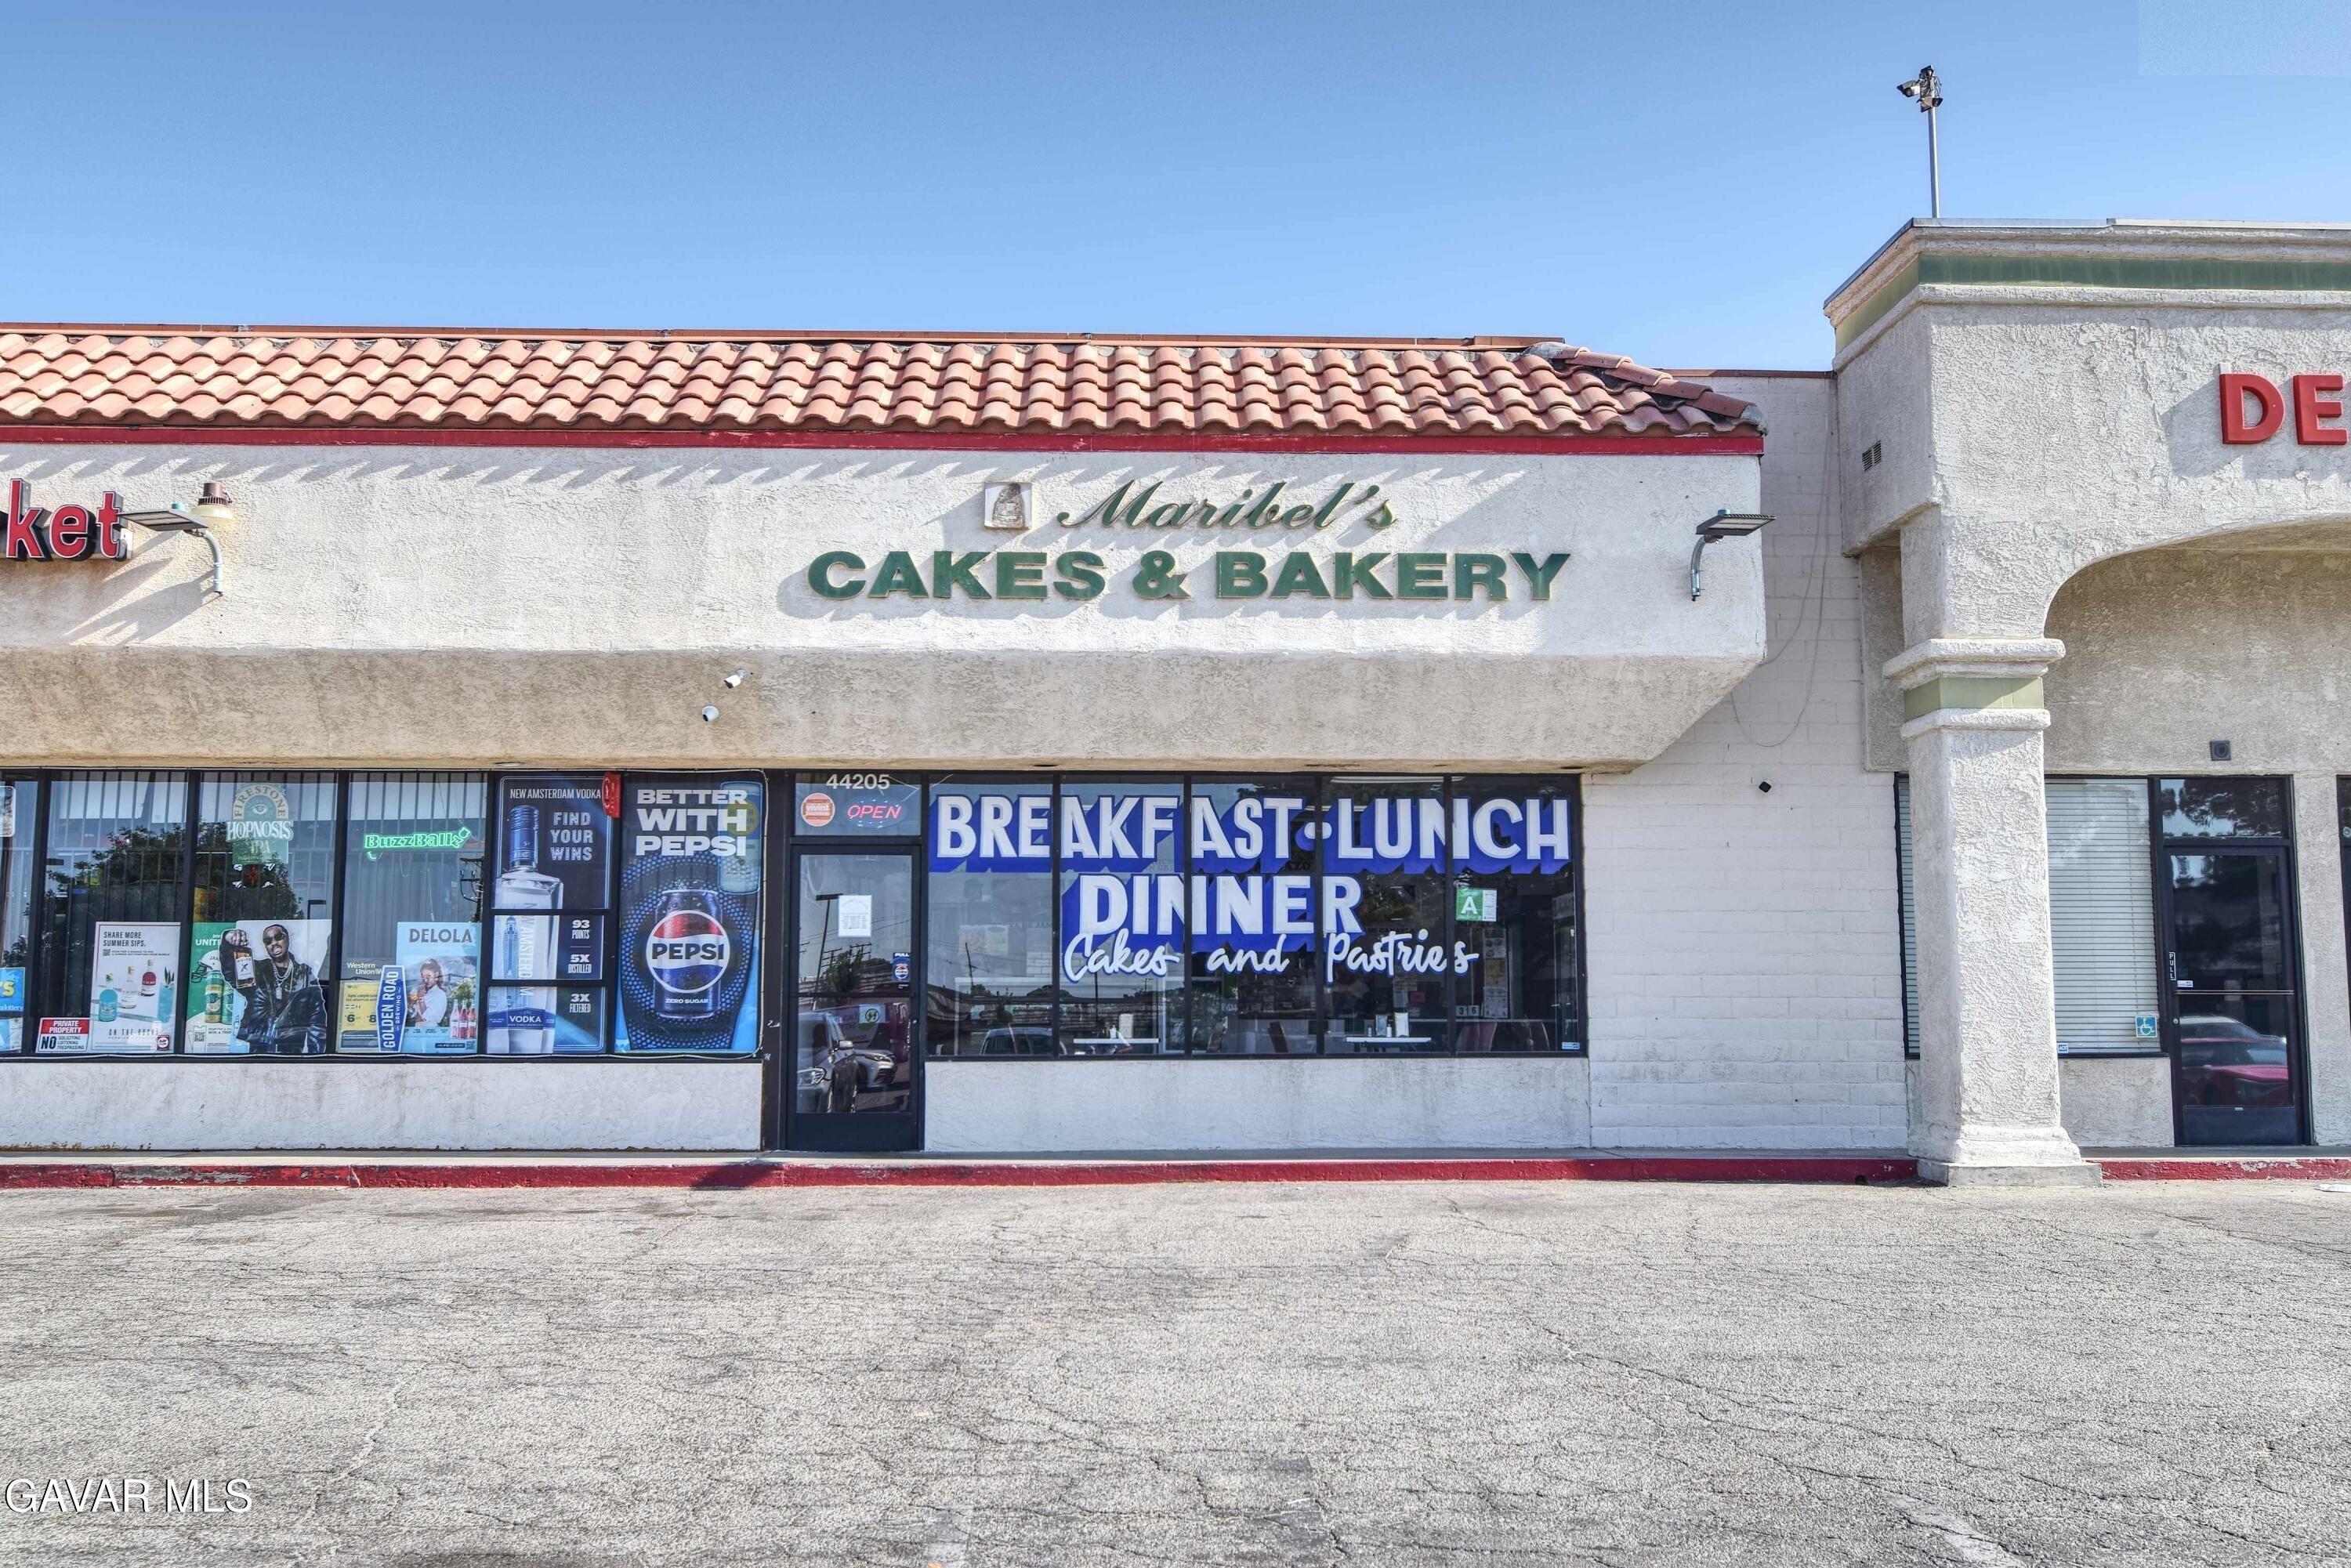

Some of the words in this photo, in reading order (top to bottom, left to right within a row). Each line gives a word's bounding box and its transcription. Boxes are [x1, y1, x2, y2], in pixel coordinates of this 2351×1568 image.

[2219, 373, 2348, 445] DE
[1057, 480, 1398, 530] Maribel's
[808, 551, 1106, 600] CAKES
[1132, 550, 1191, 600] &
[1215, 551, 1571, 600] BAKERY
[826, 773, 890, 790] 44205
[234, 785, 285, 817] FIRESTONE
[510, 788, 526, 799] NEW
[527, 788, 574, 799] AMSTERDAM
[576, 788, 602, 799] VODKA
[636, 789, 748, 805] BETTER
[553, 812, 591, 826] FIND
[846, 804, 902, 819] OPEN
[636, 809, 748, 832] WITH
[936, 795, 1303, 860] BREAKFAST
[1338, 798, 1570, 860] LUNCH
[226, 820, 293, 842] HOPNOSIS
[550, 829, 593, 843] YOUR
[550, 846, 593, 861] WINS
[636, 835, 747, 856] PEPSI
[1078, 874, 1364, 935] DINNER
[1460, 896, 1478, 914] A
[571, 919, 590, 929] 93
[409, 928, 473, 943] DELOLA
[571, 929, 590, 940] POINTS
[570, 954, 590, 963] 5X
[651, 942, 725, 961] PEPSI
[1063, 928, 1180, 982] Cakes
[1207, 933, 1290, 972] and
[1324, 929, 1480, 983] Pastries
[568, 964, 592, 974] DISTILLED
[382, 971, 399, 1001] ROAD
[571, 993, 590, 1002] 3X
[569, 1003, 591, 1013] FILTERED
[381, 1004, 396, 1049] GOLDEN
[41, 1036, 57, 1050] NO
